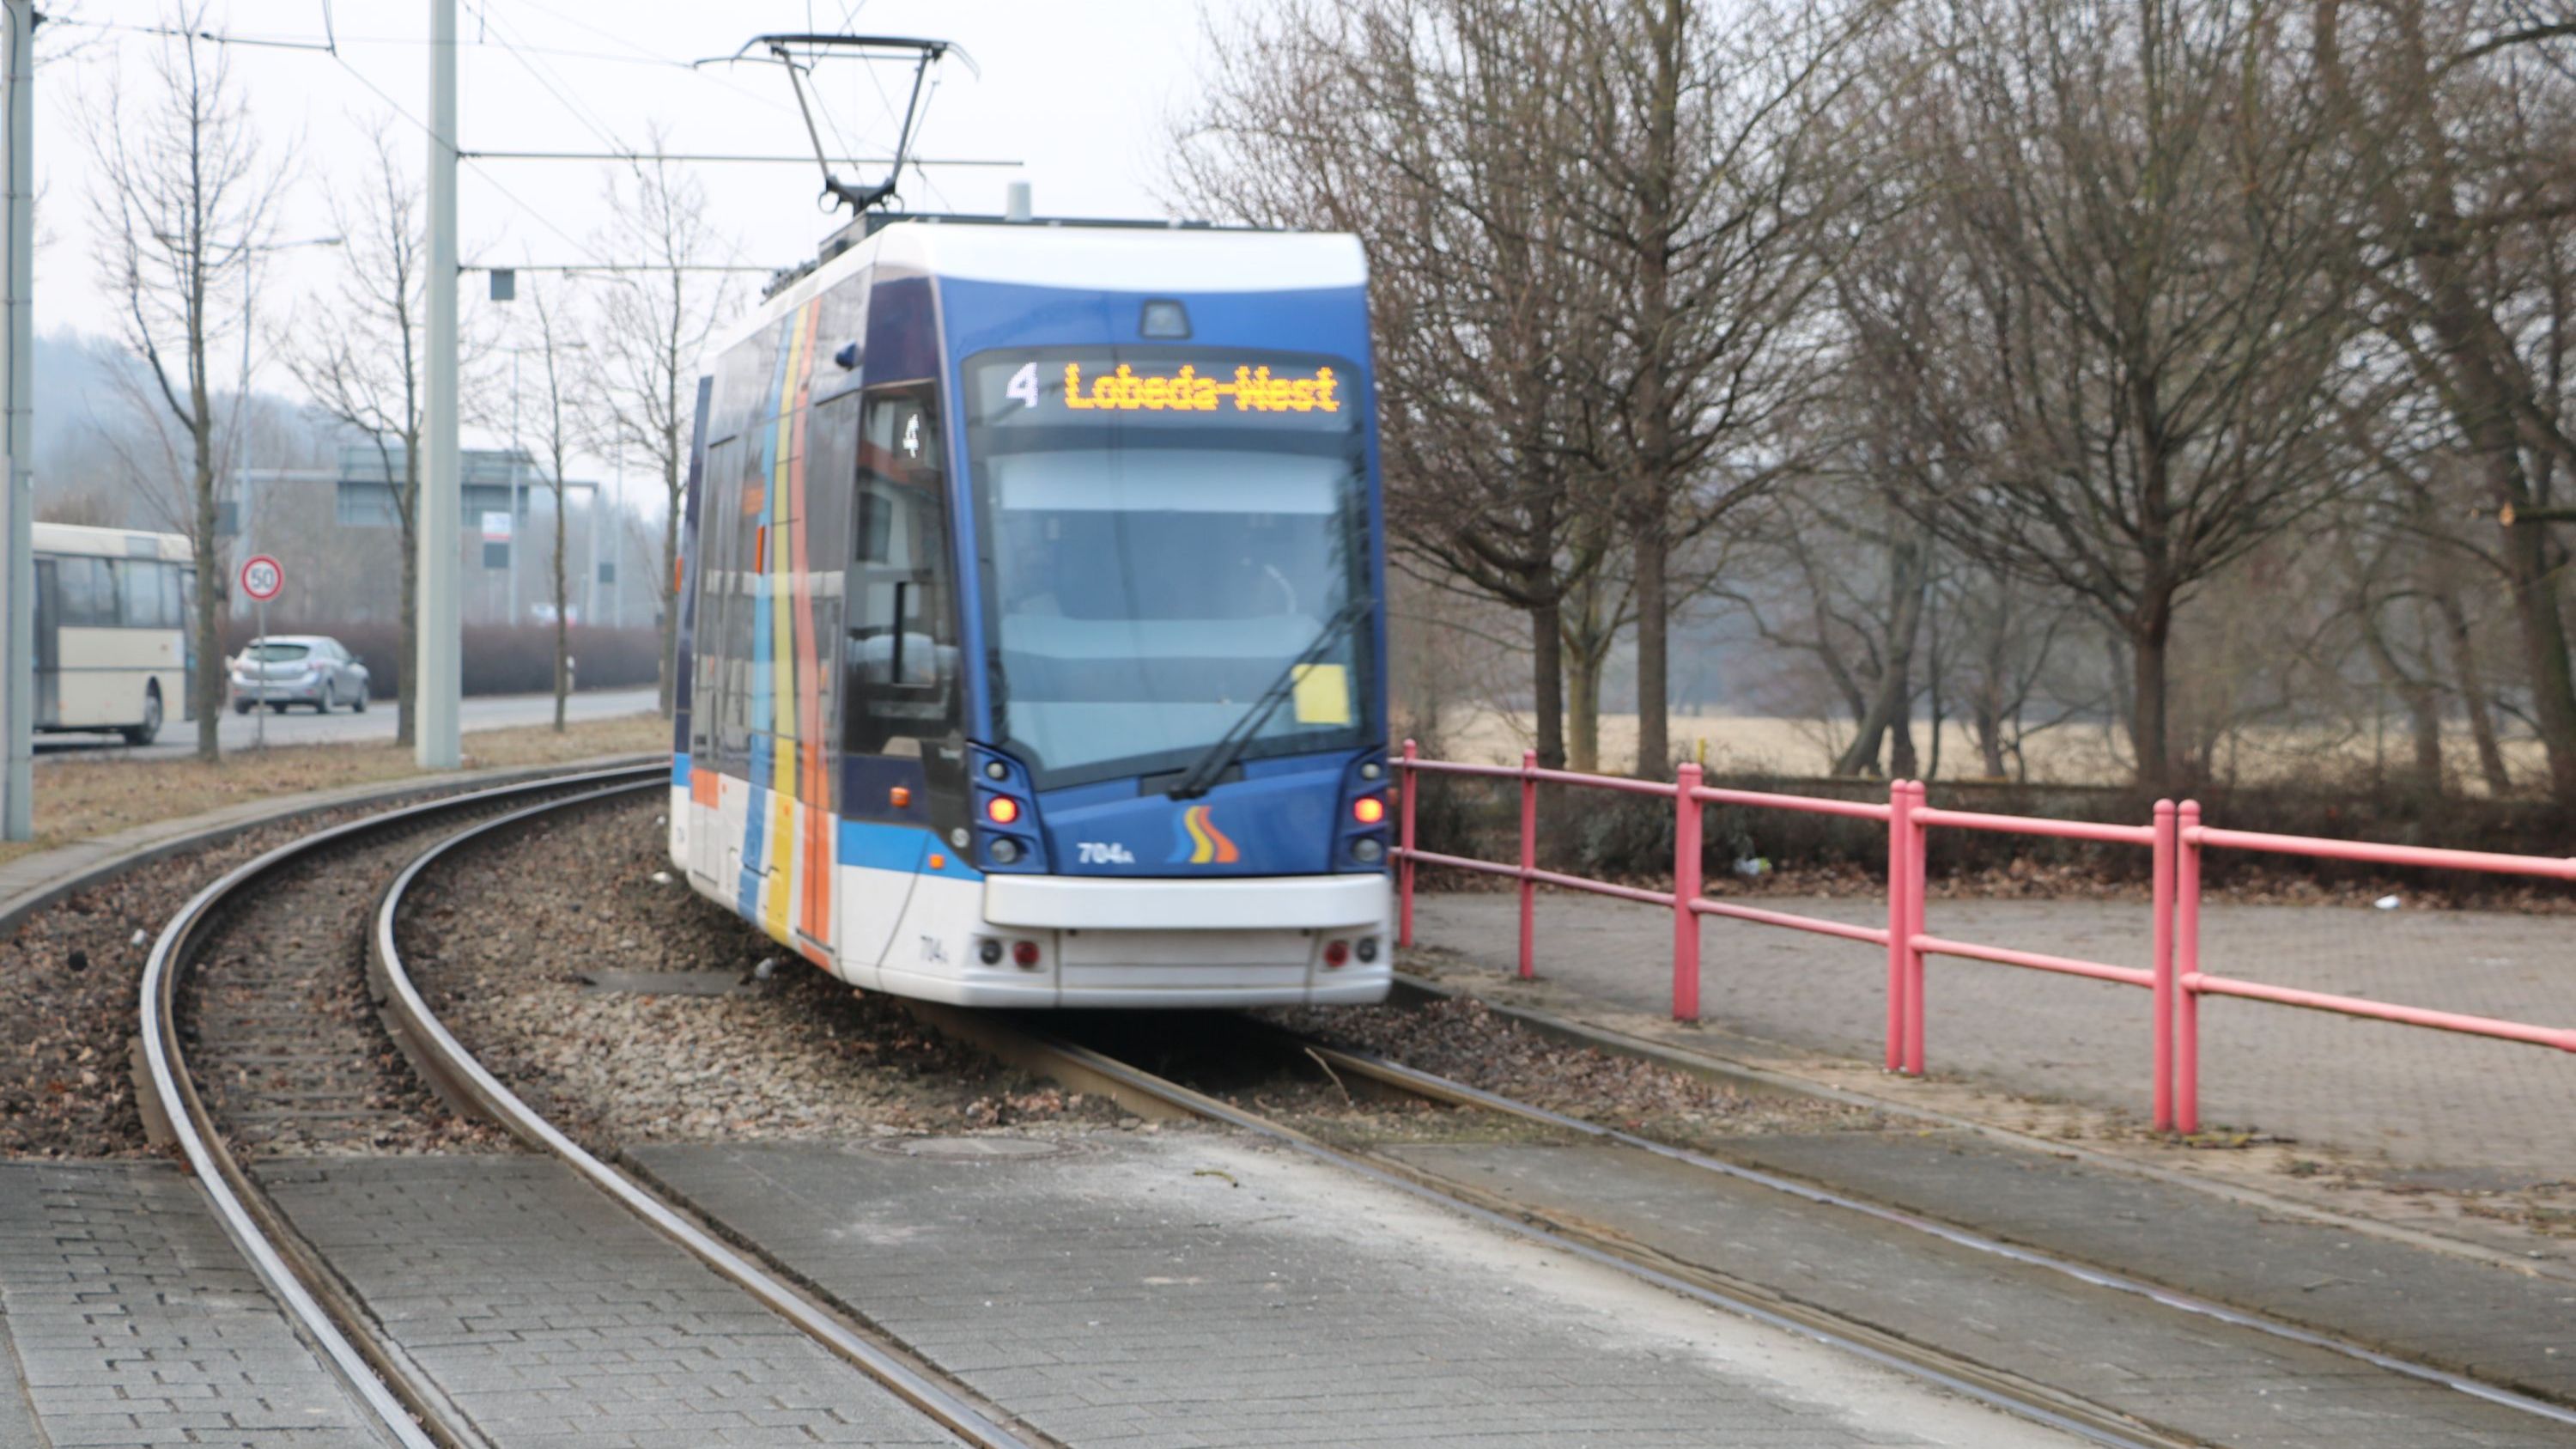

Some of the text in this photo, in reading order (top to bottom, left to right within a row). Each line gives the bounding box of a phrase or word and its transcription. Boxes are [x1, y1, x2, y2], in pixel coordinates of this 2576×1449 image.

[1005, 362, 1340, 412] 4 Lobeda-West
[902, 413, 919, 459] 4
[251, 567, 275, 589] 50
